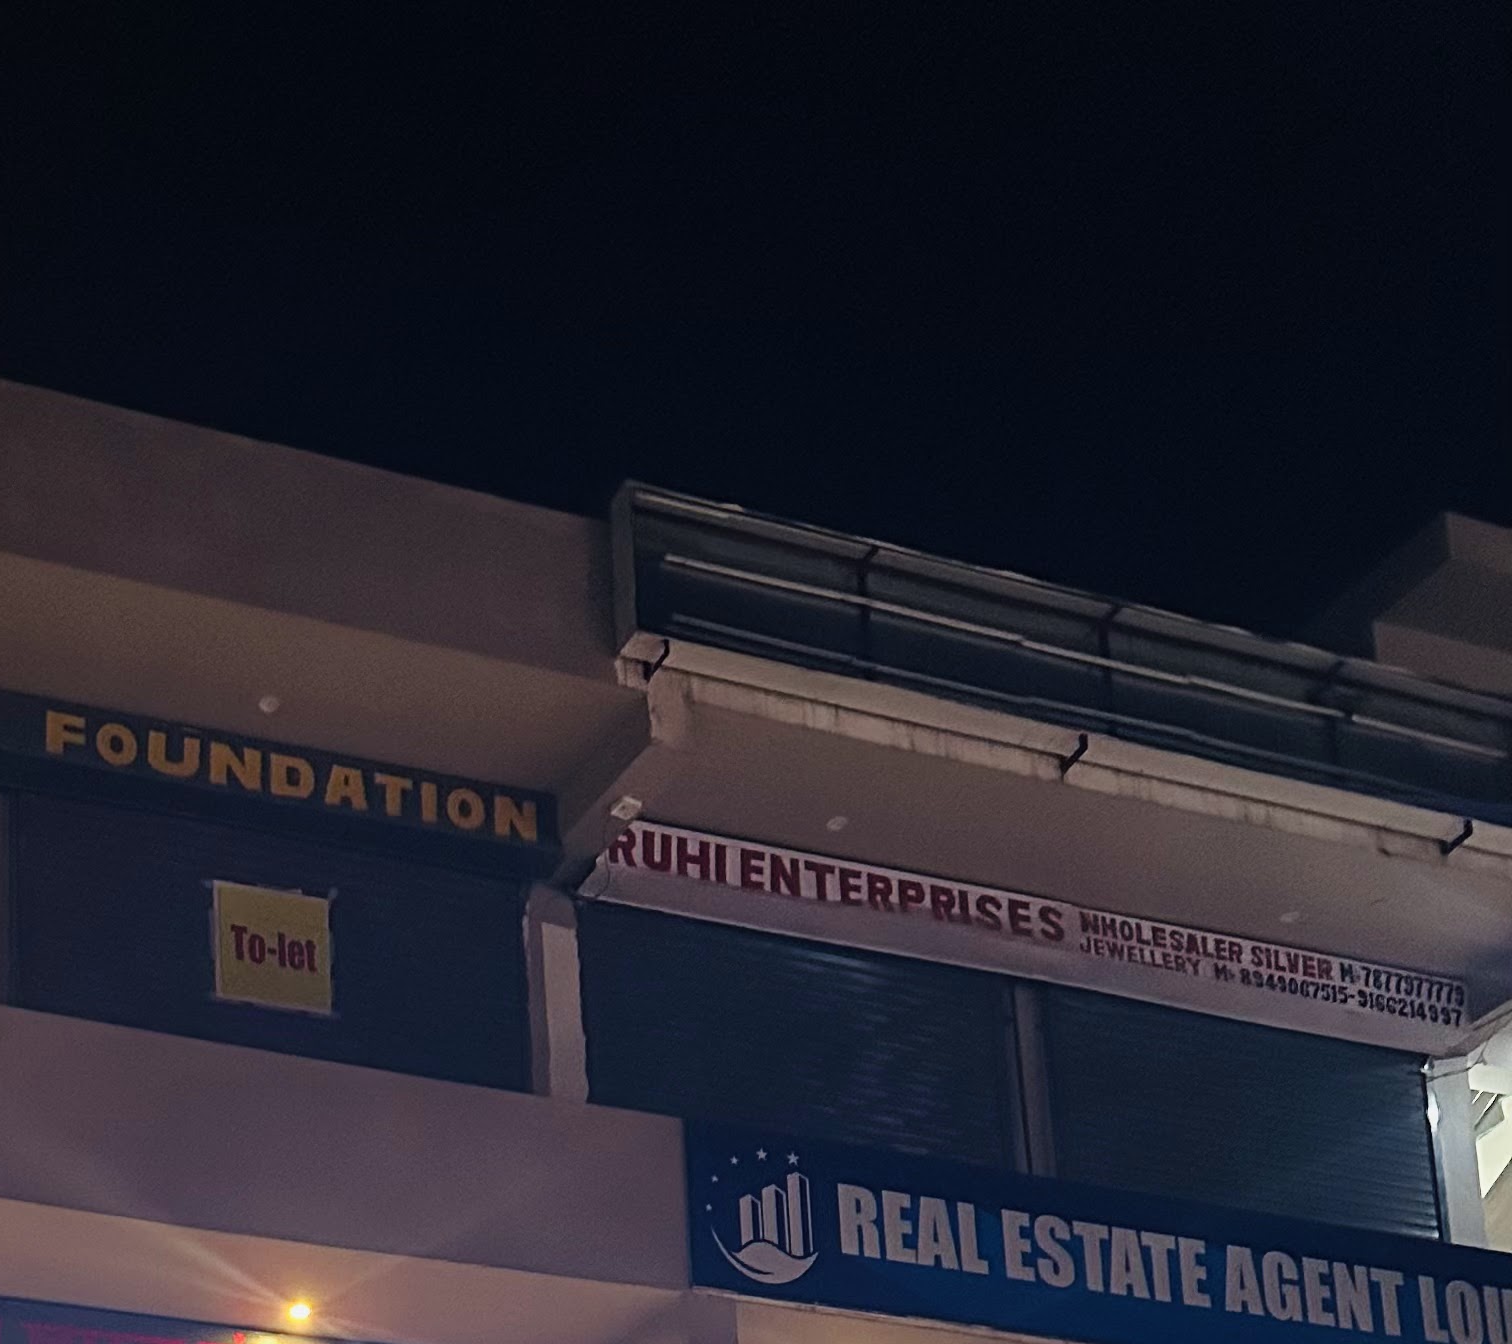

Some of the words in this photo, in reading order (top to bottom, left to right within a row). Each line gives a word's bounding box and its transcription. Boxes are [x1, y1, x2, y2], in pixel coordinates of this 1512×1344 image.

[45, 709, 538, 841] FOUNDATION
[608, 827, 728, 884] RUHI
[740, 847, 1065, 942] ENTERPRISES
[230, 924, 318, 973] To-let
[1079, 911, 1243, 964] WHOLESALER
[1251, 945, 1335, 980] SILVER
[1079, 936, 1201, 976] JEWELLERY
[837, 1182, 990, 1276] REAL
[1001, 1208, 1211, 1310] ESTATE
[1224, 1244, 1403, 1337] AGENT
